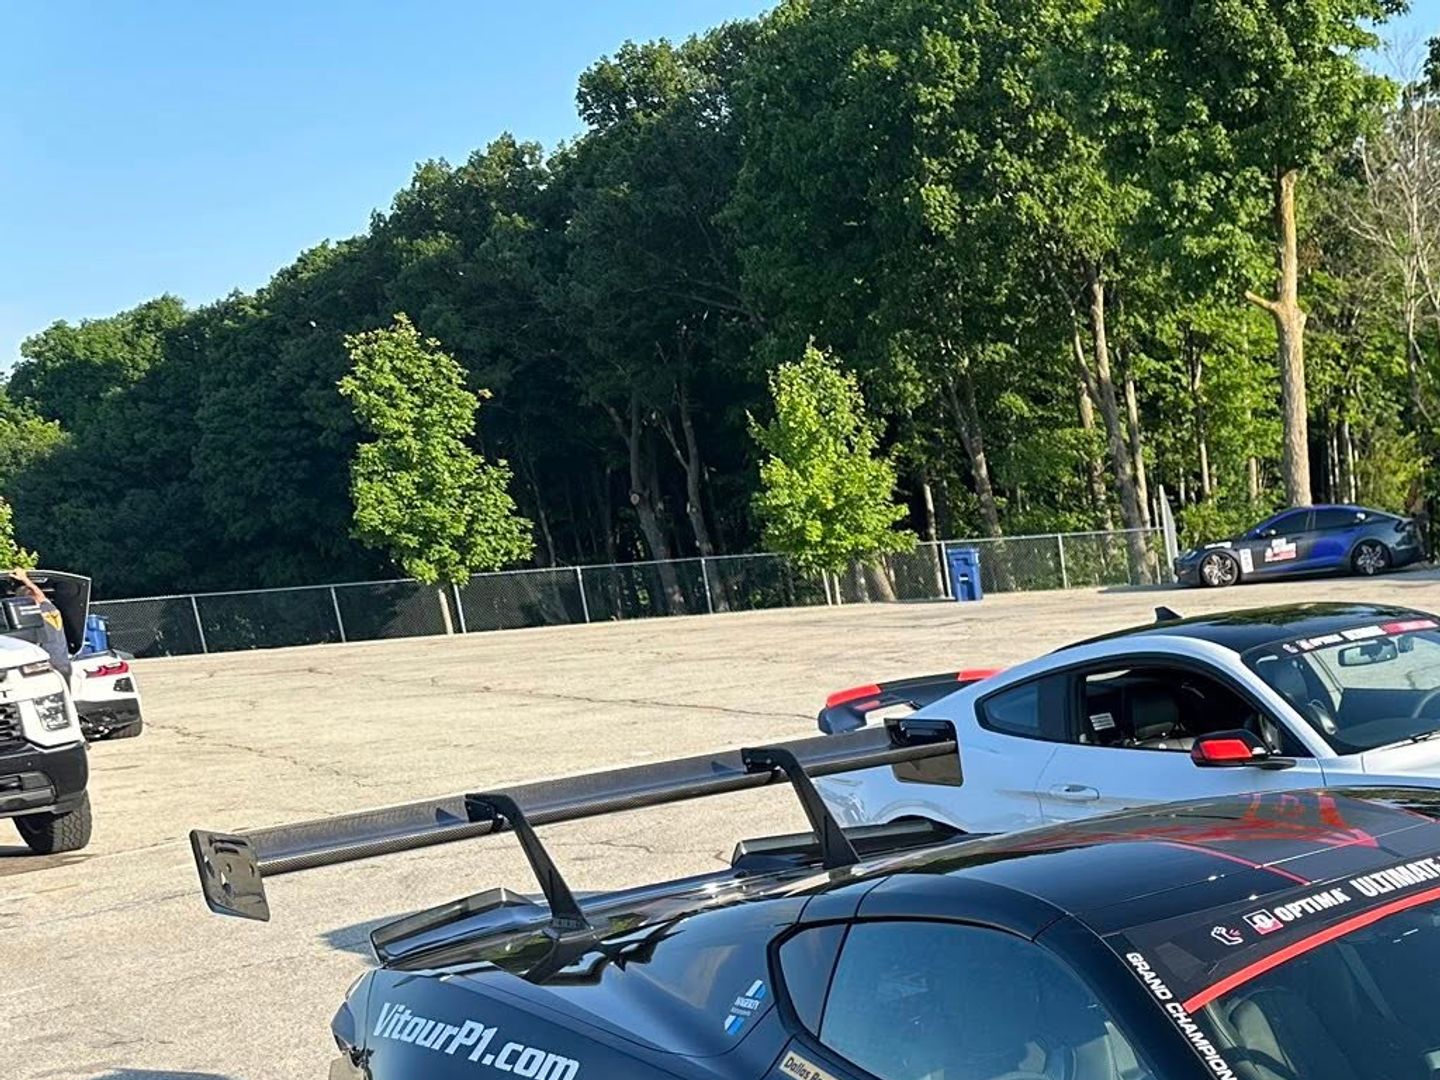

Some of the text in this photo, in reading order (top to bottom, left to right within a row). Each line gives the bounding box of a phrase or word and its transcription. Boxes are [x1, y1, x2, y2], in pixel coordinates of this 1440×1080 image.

[1273, 888, 1349, 923] OPTIMA
[1126, 952, 1173, 1001] GRAND
[784, 1056, 809, 1080] Dallas
